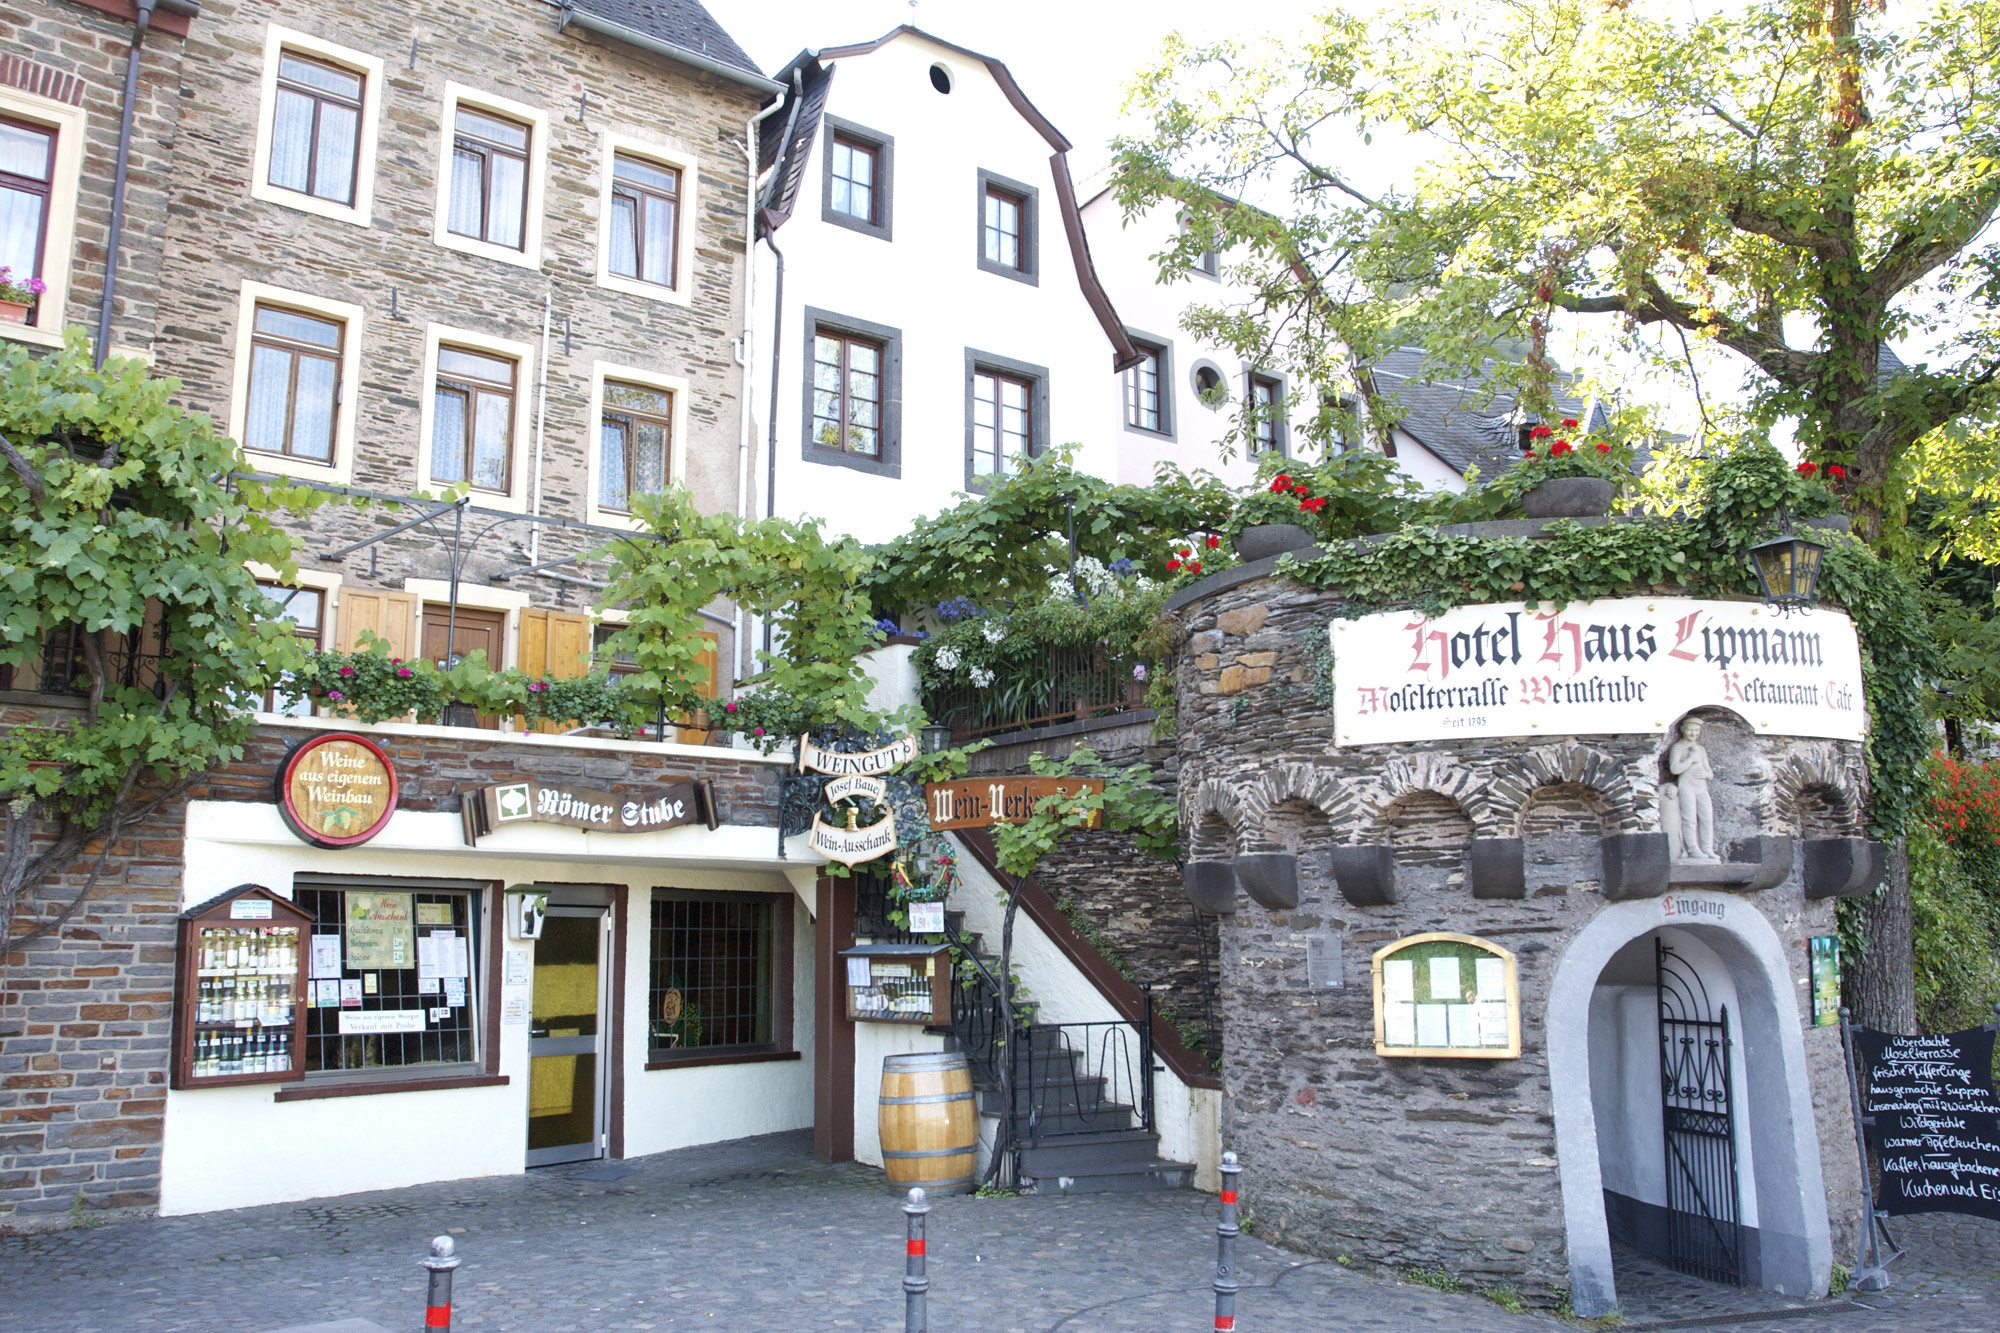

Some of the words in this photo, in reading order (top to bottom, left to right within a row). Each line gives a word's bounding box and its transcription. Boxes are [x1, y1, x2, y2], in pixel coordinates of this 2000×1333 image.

[1402, 612, 1522, 681] Hotel
[1534, 609, 1657, 677] Haus
[1668, 610, 1824, 670] Lipmann
[1519, 675, 1648, 705] Weinstube
[1721, 672, 1819, 706] Restaurant
[1443, 717, 1464, 728] Seit
[1468, 716, 1487, 727] 1795
[320, 751, 366, 769] Weine
[816, 748, 898, 775] WEINGUT
[299, 771, 324, 782] aus
[327, 770, 382, 788] eigenem
[830, 776, 854, 800] Josef
[307, 785, 374, 804] Weinbau
[932, 783, 1068, 823] Wein-Verk
[537, 788, 614, 824] Römer
[621, 797, 685, 827] Stube
[816, 827, 892, 853] Wein-Ausschank
[369, 910, 409, 921] Ausschank
[1662, 895, 1725, 920] Eingang
[350, 1022, 378, 1031] Verkauf
[380, 1022, 393, 1030] mit
[396, 1022, 416, 1030] Probe
[1881, 1046, 1961, 1060] Moselterrasse
[1872, 1065, 1906, 1081] frische
[1905, 1063, 1972, 1085] Pfifferlinge
[1870, 1083, 1942, 1098] hausgemachte
[1945, 1083, 1989, 1100] Suppen
[1923, 1099, 1940, 1110] mit
[1900, 1115, 1967, 1133] Wildgerichte
[1884, 1138, 1923, 1148] warmer
[1901, 1178, 1950, 1198] Kuchen
[1950, 1179, 1979, 1198] und
